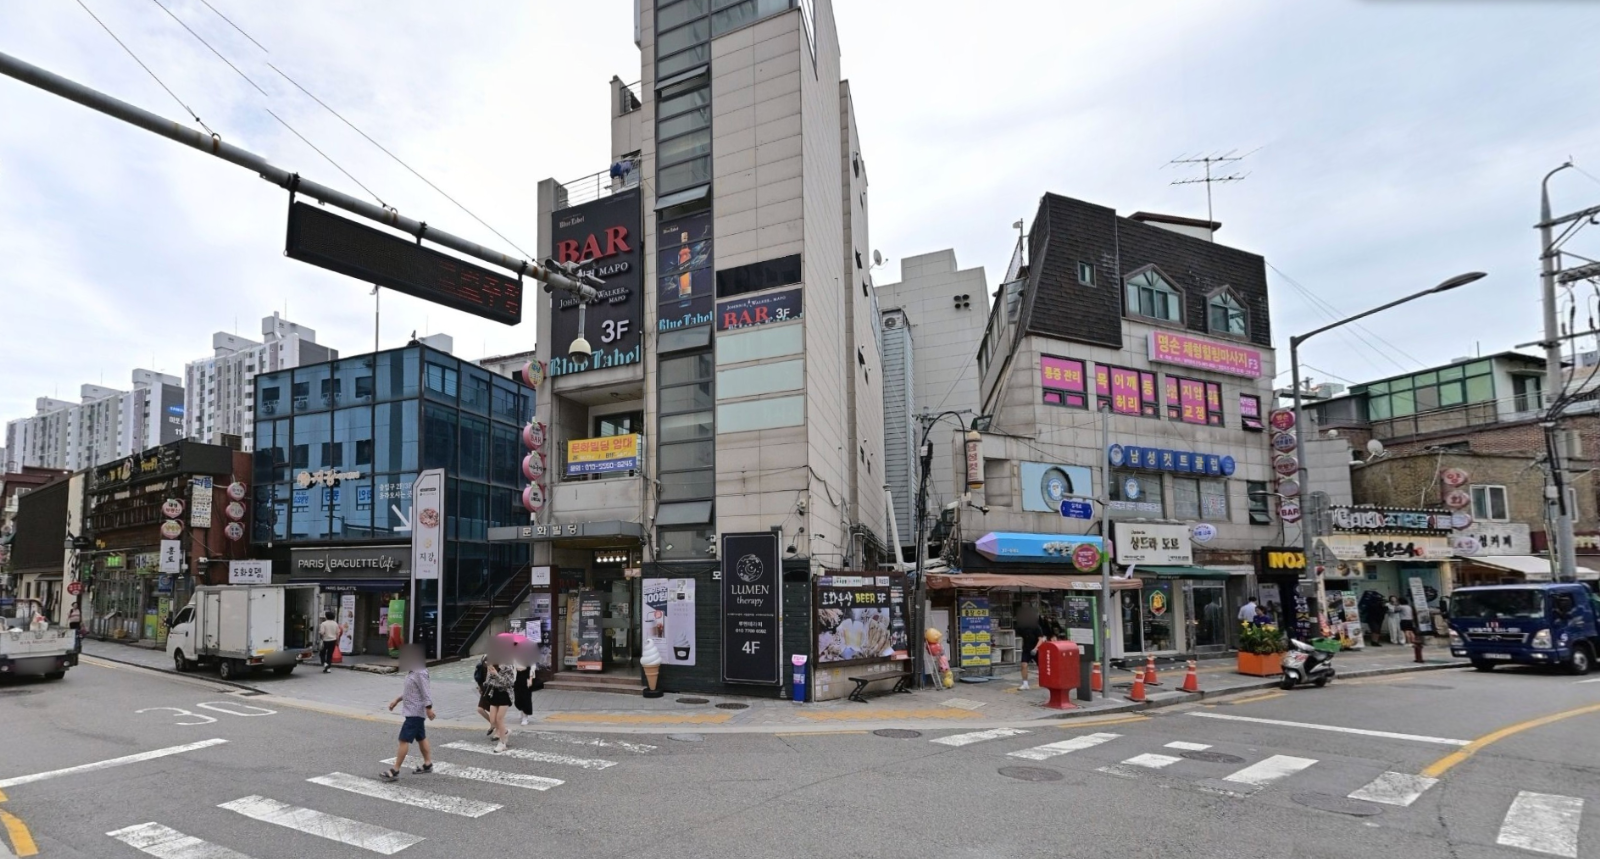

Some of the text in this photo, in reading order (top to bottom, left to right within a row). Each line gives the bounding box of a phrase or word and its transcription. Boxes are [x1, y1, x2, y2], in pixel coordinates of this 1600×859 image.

[559, 218, 571, 229] Blue
[556, 226, 632, 265] BAR
[599, 262, 629, 276] MAPO
[608, 295, 627, 304] MAPO
[724, 306, 769, 328] BAR
[776, 307, 791, 319] 3F
[600, 319, 631, 344] 3F
[1044, 366, 1080, 383] 통증 관리
[1096, 372, 1107, 388] 목
[1114, 374, 1137, 391] 어깨
[1183, 385, 1202, 401] 지압
[1116, 395, 1138, 413] 허리
[1184, 405, 1204, 420] 교정
[571, 436, 633, 453] 문화빌딩 임대
[298, 559, 324, 568] PARIS
[330, 558, 378, 568] BAGUETTE
[731, 584, 769, 595] LUMEN
[737, 596, 764, 607] therapy
[855, 592, 876, 604] BEER
[741, 641, 761, 655] 4F
[135, 701, 278, 726] 30
